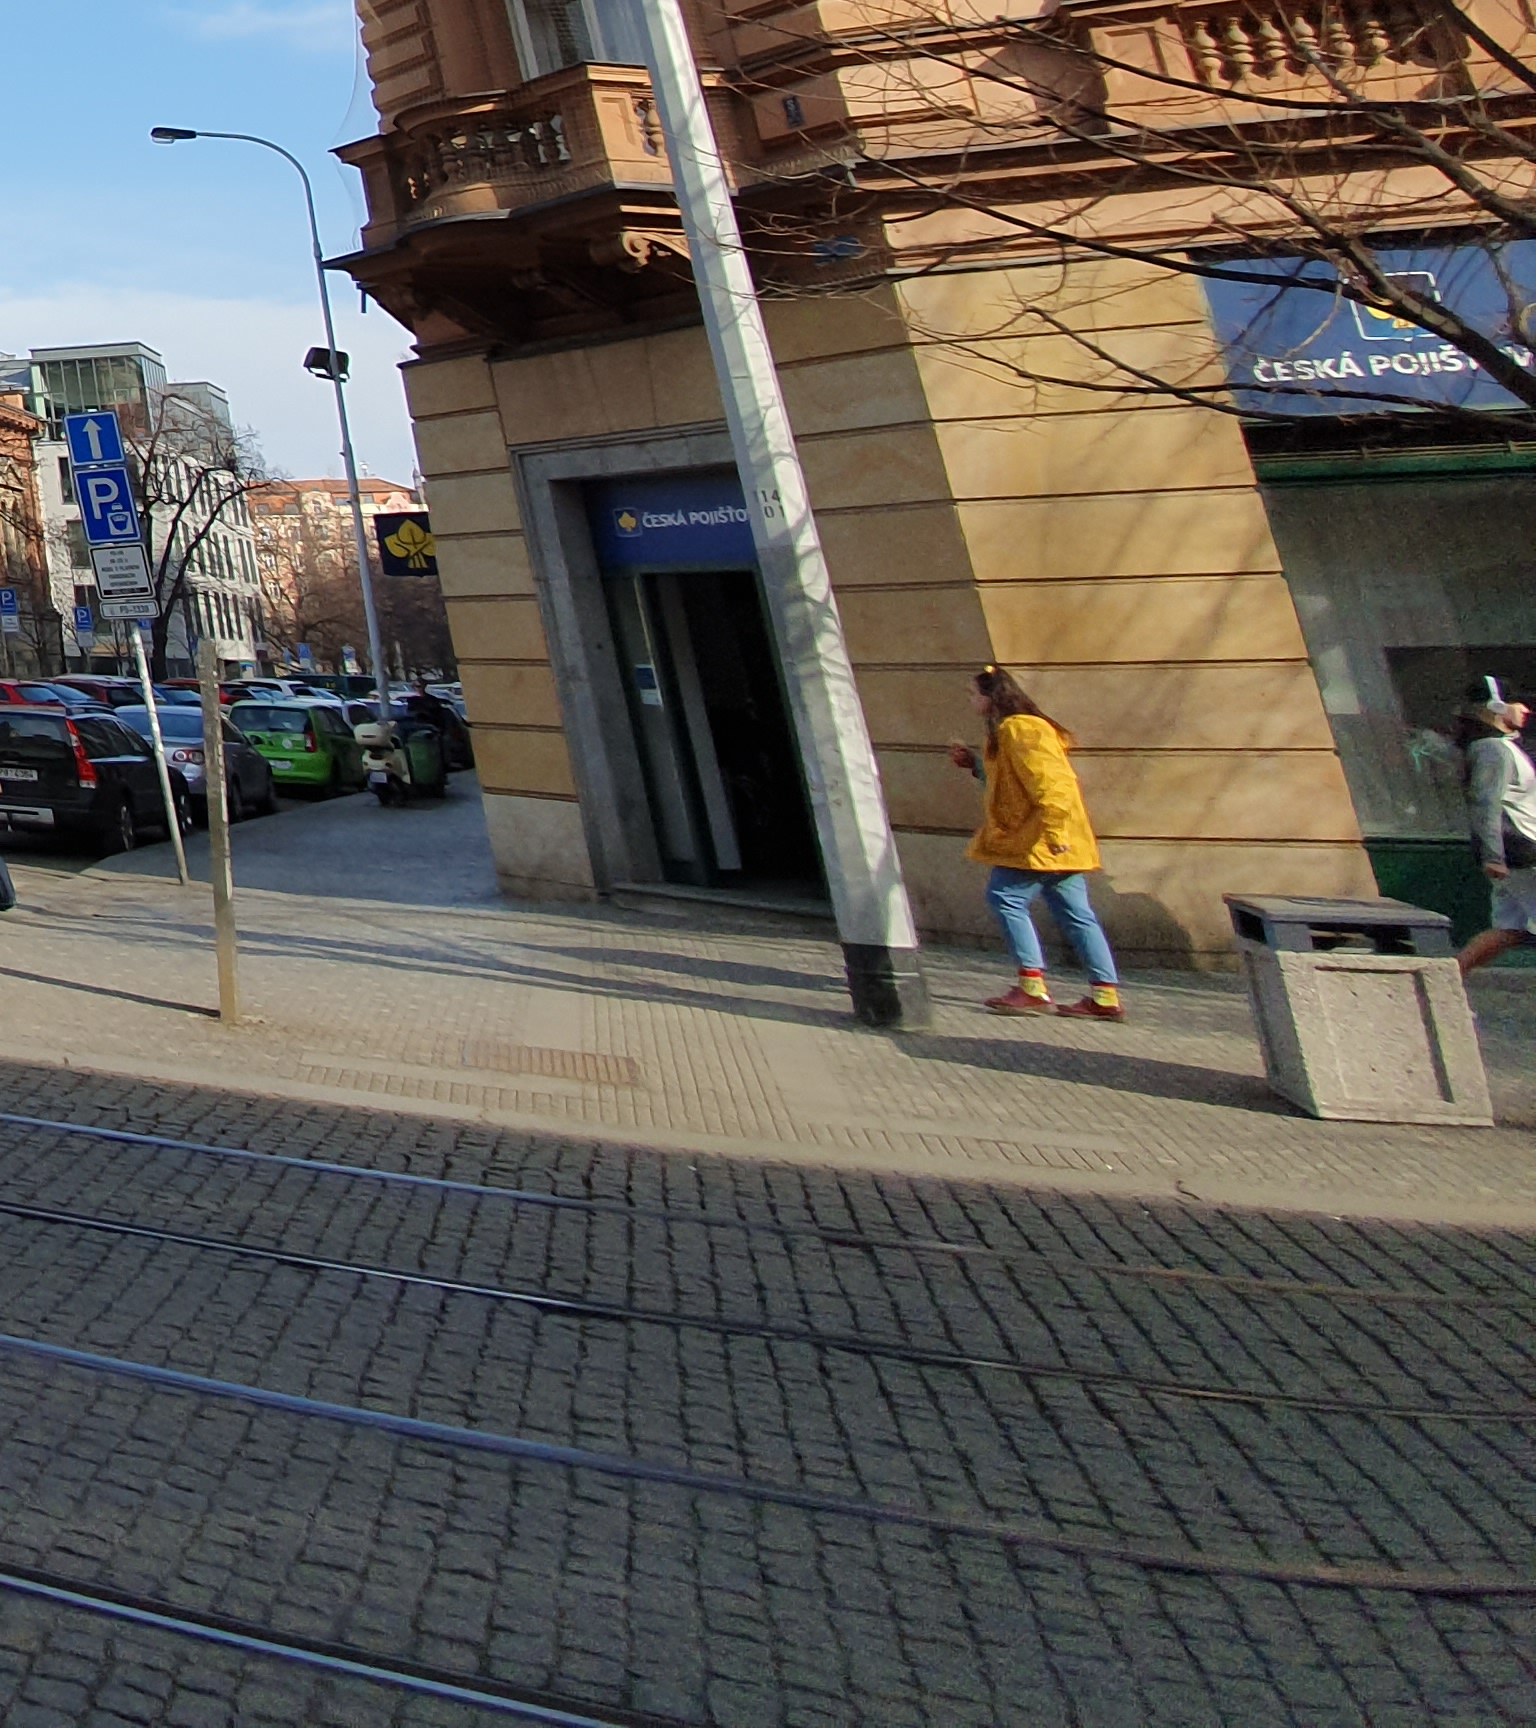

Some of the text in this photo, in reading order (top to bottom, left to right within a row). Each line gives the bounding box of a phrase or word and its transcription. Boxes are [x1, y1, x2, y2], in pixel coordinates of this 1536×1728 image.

[1252, 350, 1366, 383] ČESKÁ
[87, 477, 119, 520] P
[641, 509, 689, 528] ČESKÁ
